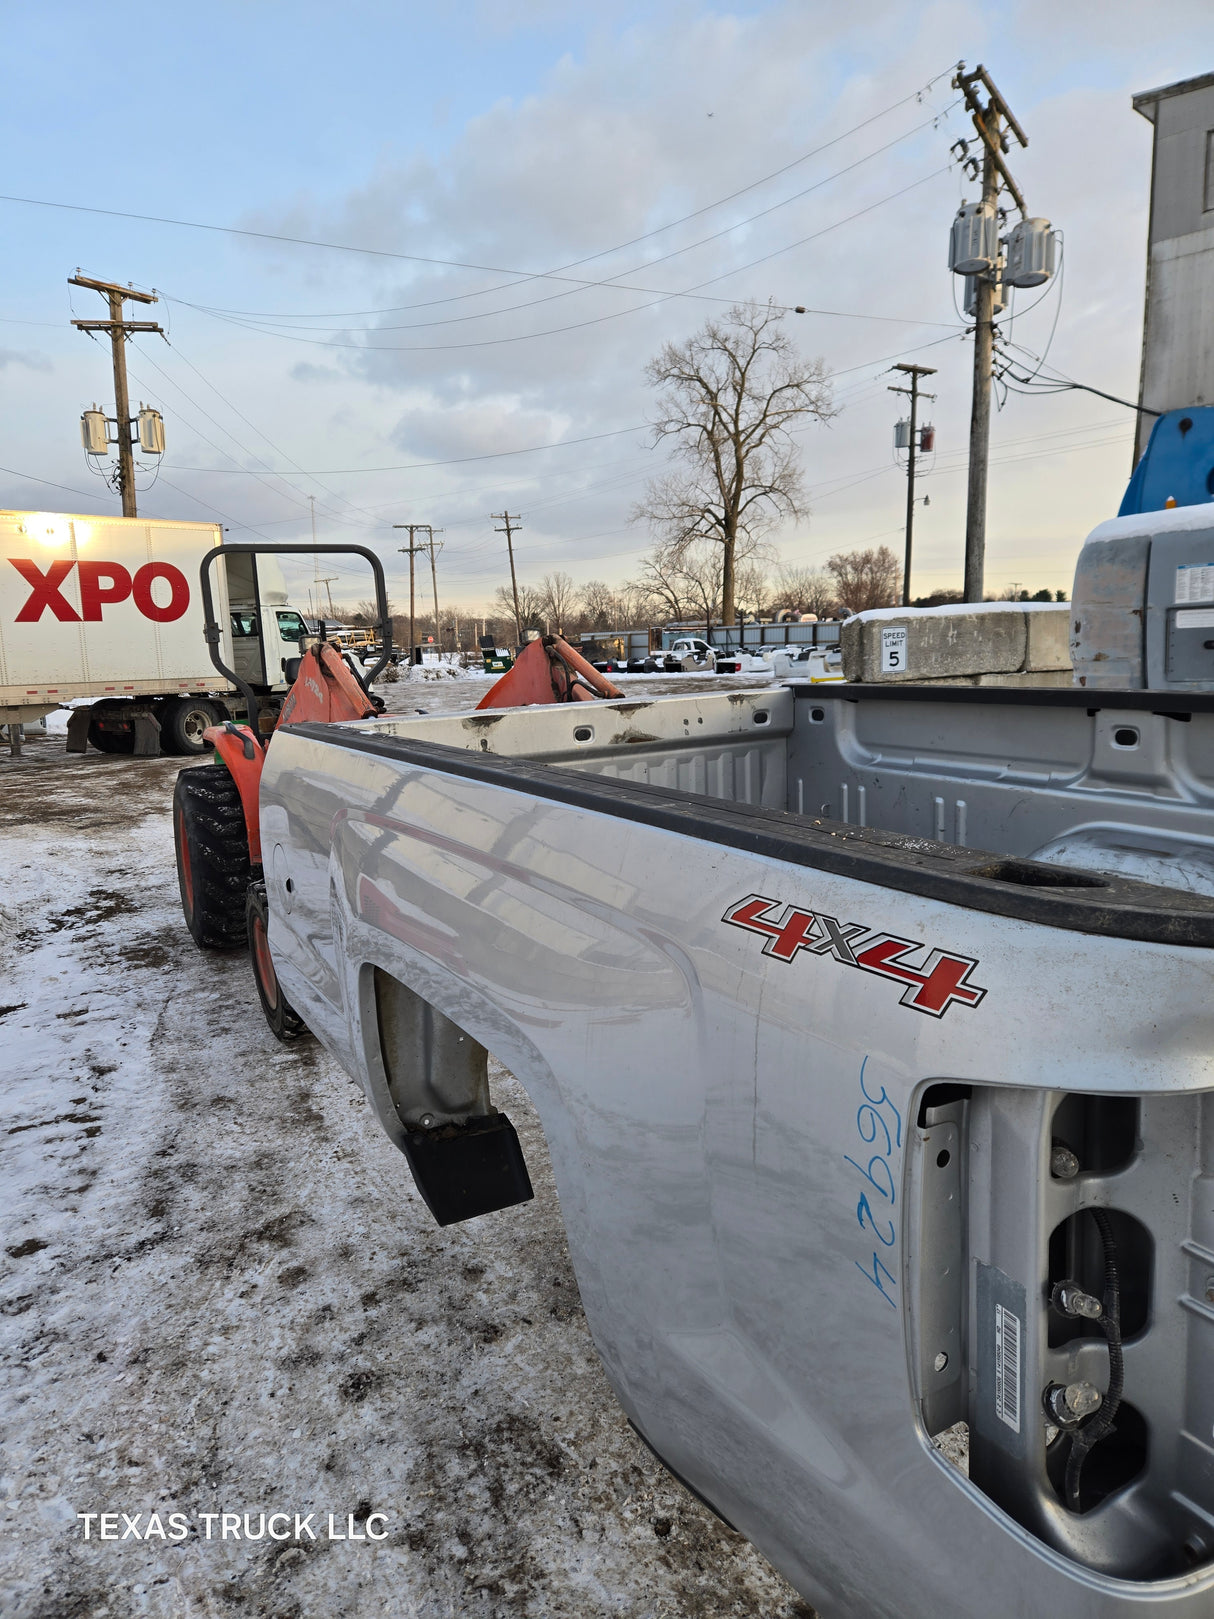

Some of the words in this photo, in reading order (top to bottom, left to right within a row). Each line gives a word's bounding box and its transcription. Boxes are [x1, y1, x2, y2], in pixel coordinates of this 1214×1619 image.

[8, 558, 190, 622] XPO
[889, 651, 898, 666] 5
[845, 1055, 902, 1308] 56924
